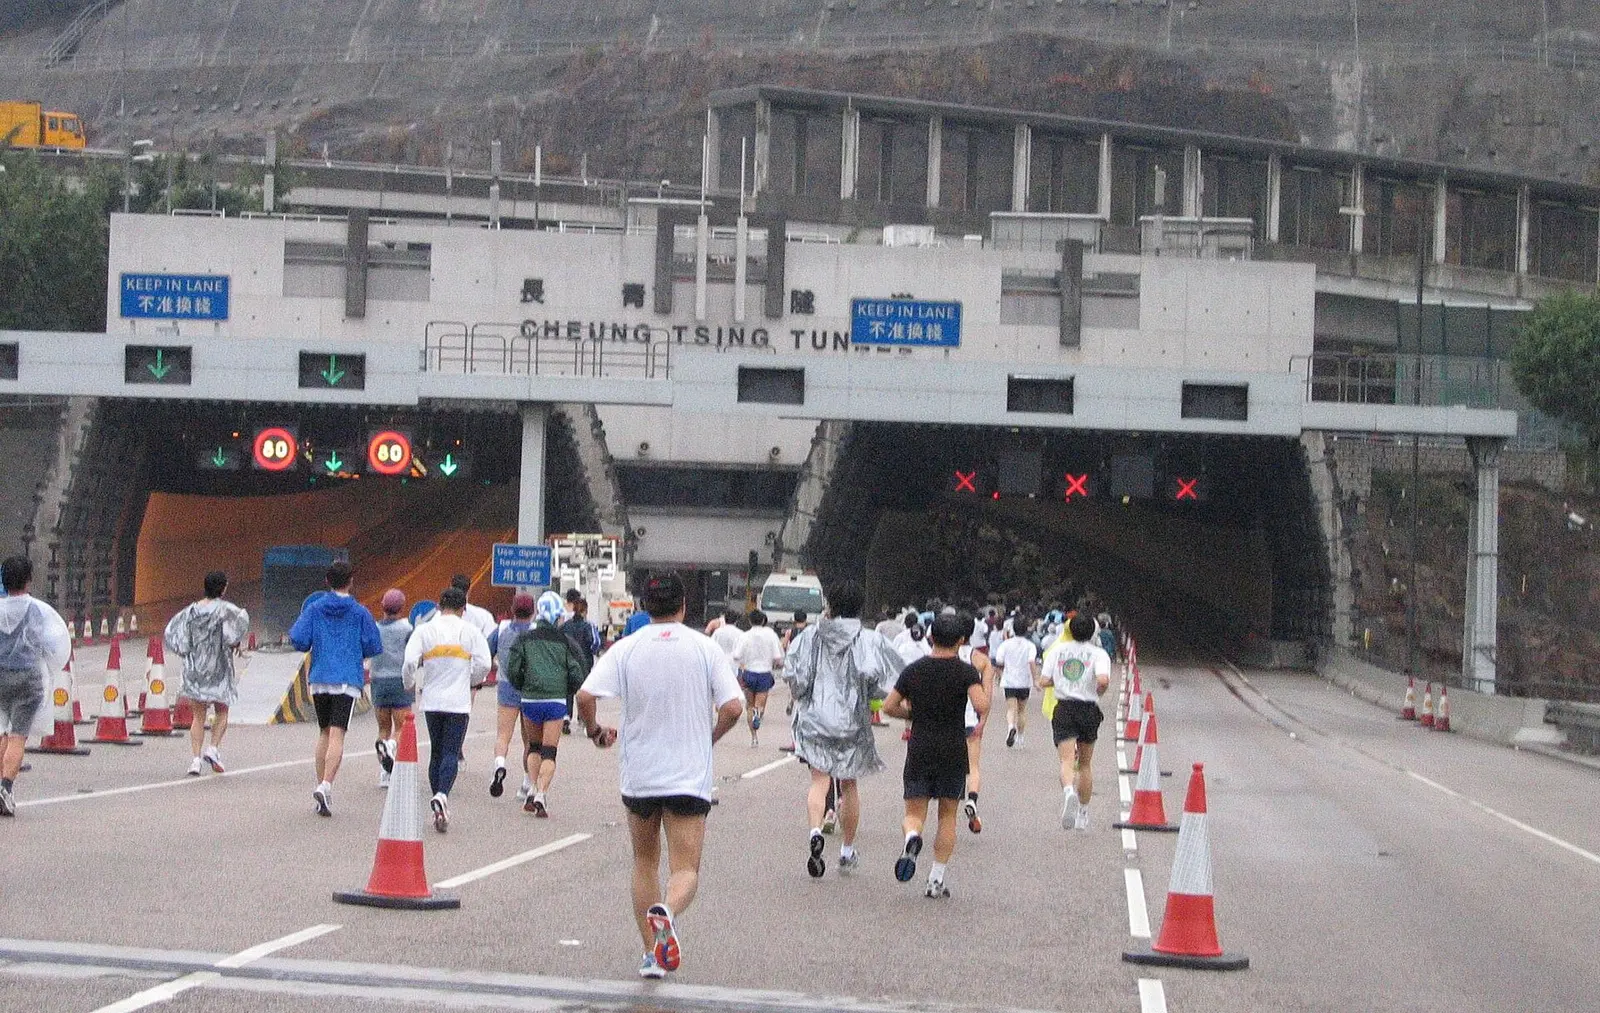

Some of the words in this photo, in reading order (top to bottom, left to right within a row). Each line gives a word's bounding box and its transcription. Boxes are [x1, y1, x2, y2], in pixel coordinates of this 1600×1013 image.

[126, 278, 162, 292] KEEP
[166, 279, 182, 292] IN
[186, 280, 223, 293] LANE
[858, 303, 894, 317] KEEP
[898, 305, 914, 318] IN
[918, 305, 955, 320] LANE
[520, 319, 651, 343] CHEUNG
[672, 325, 769, 347] TSING
[262, 439, 288, 459] 80
[377, 443, 402, 463] 80
[497, 547, 514, 557] Use
[518, 549, 549, 560] dipped
[499, 559, 545, 569] headlights
